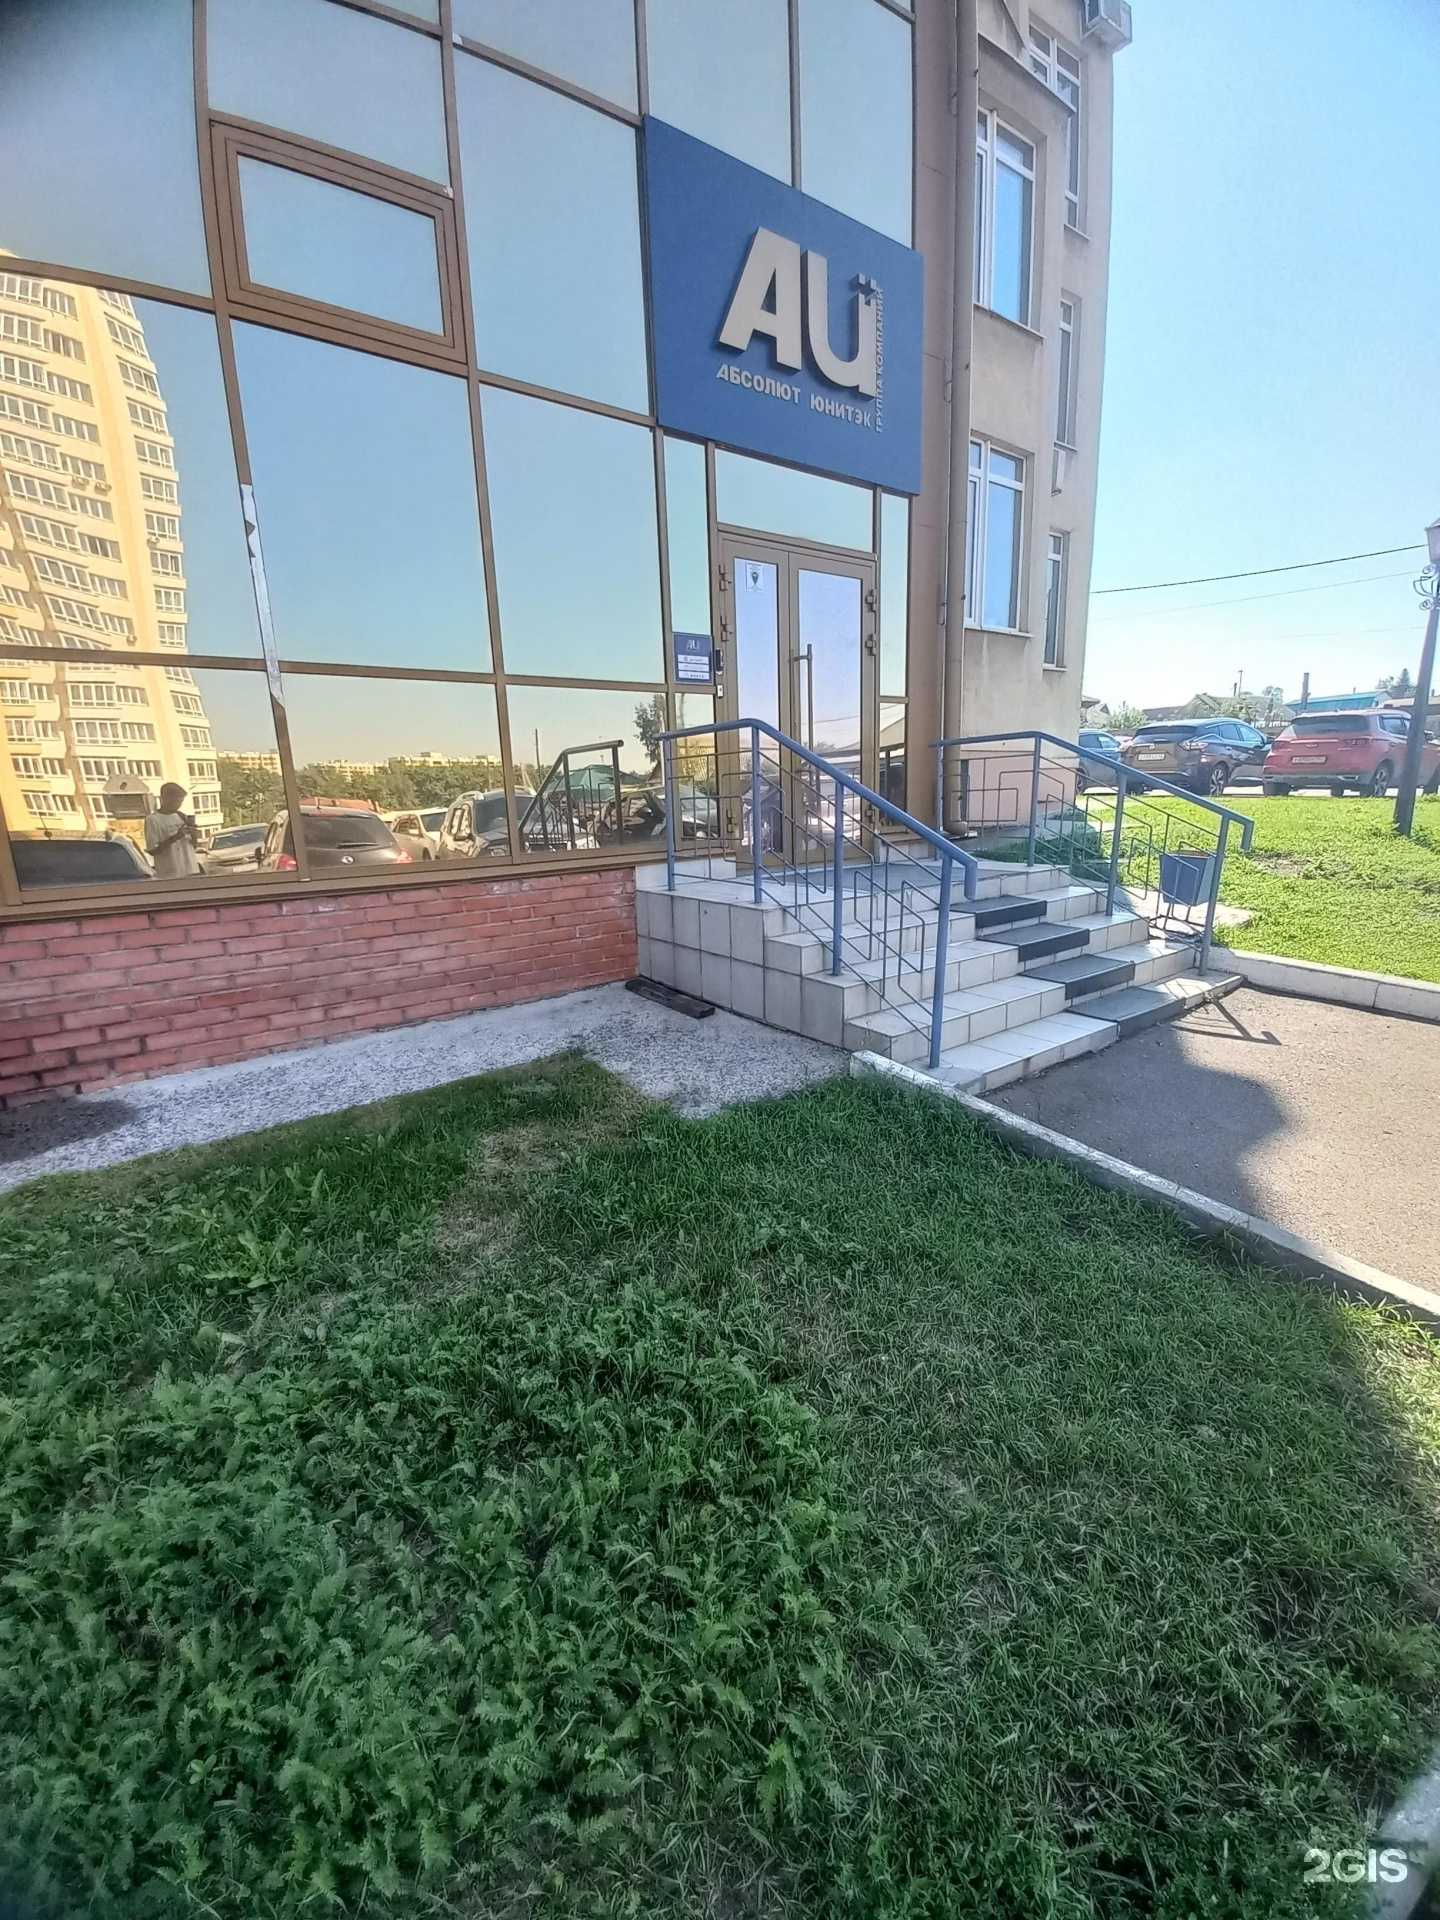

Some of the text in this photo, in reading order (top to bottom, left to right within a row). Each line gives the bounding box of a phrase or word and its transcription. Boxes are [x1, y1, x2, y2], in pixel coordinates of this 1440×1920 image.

[716, 363, 872, 429] АБСОЛЮТ ЮНИТЭК
[875, 380, 884, 433] ГРУППА
